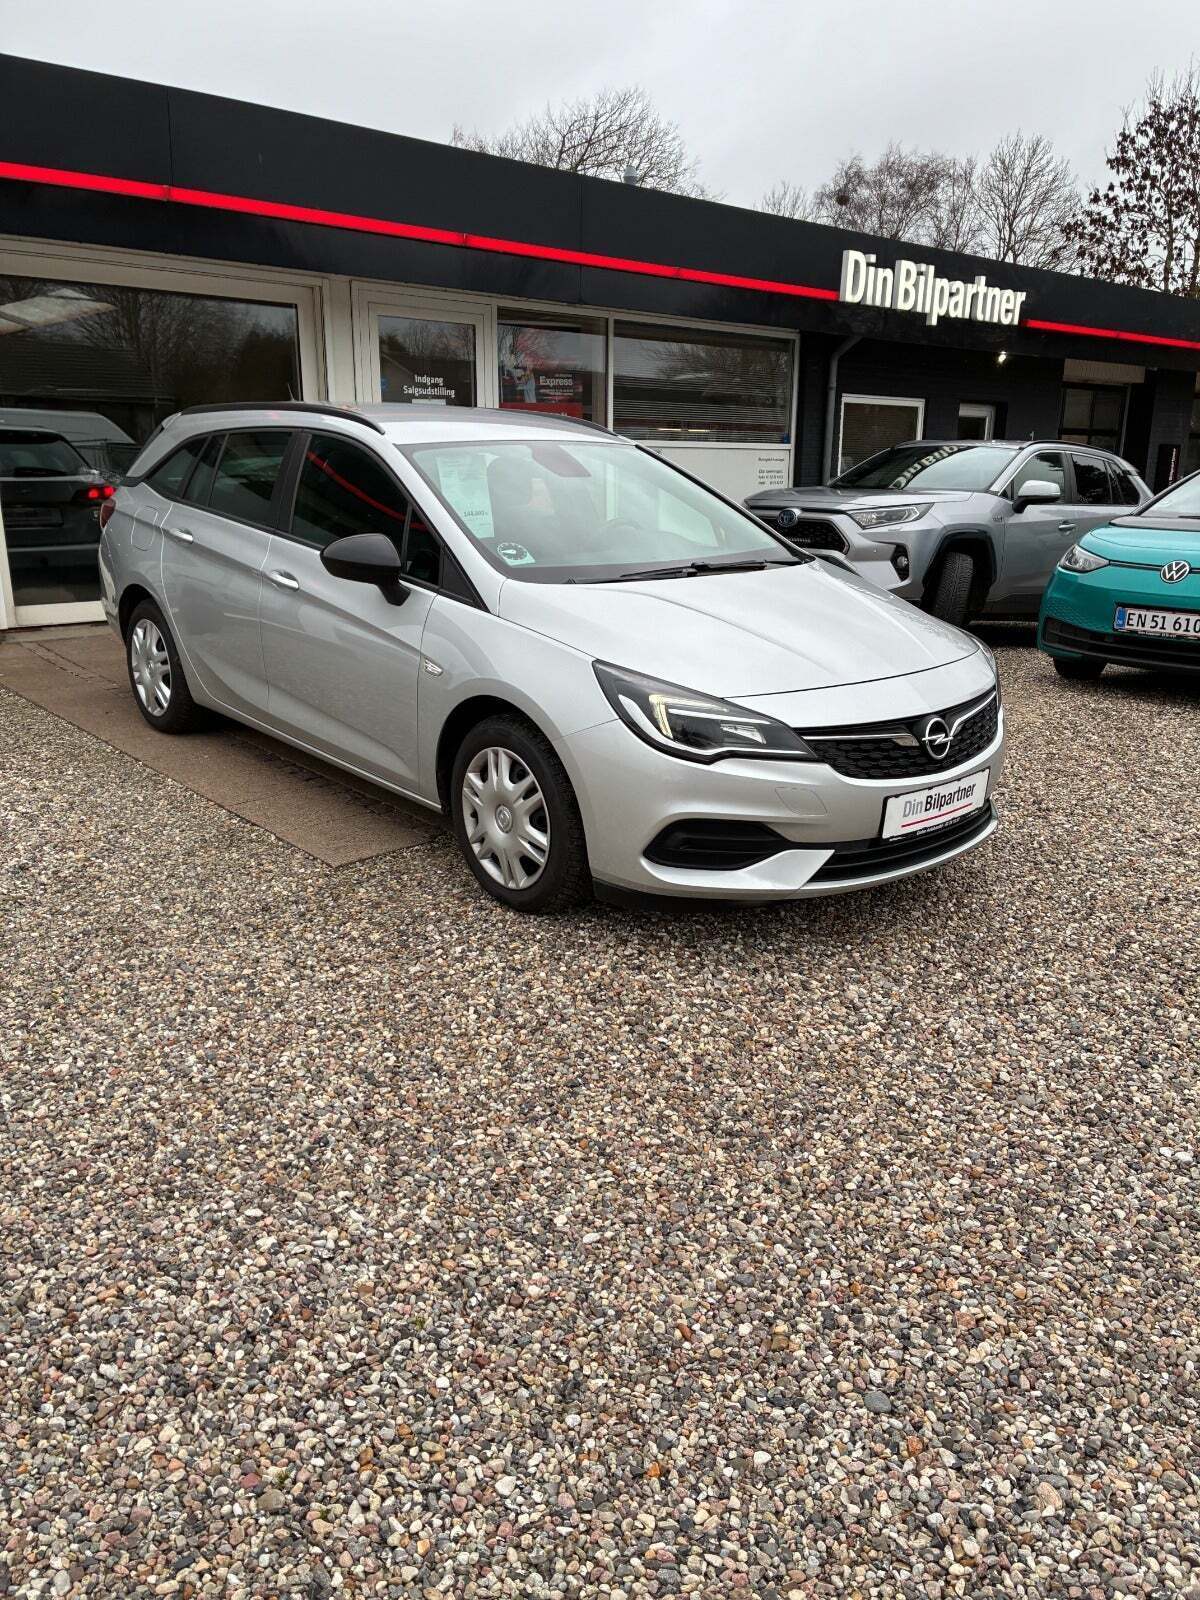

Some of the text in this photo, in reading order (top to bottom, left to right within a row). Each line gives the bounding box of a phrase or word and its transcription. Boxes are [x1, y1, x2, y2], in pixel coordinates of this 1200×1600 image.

[414, 374, 444, 386] Indgang
[539, 375, 573, 388] Express
[403, 385, 456, 398] Salgsudstilling
[1126, 612, 1200, 634] EN 51 610
